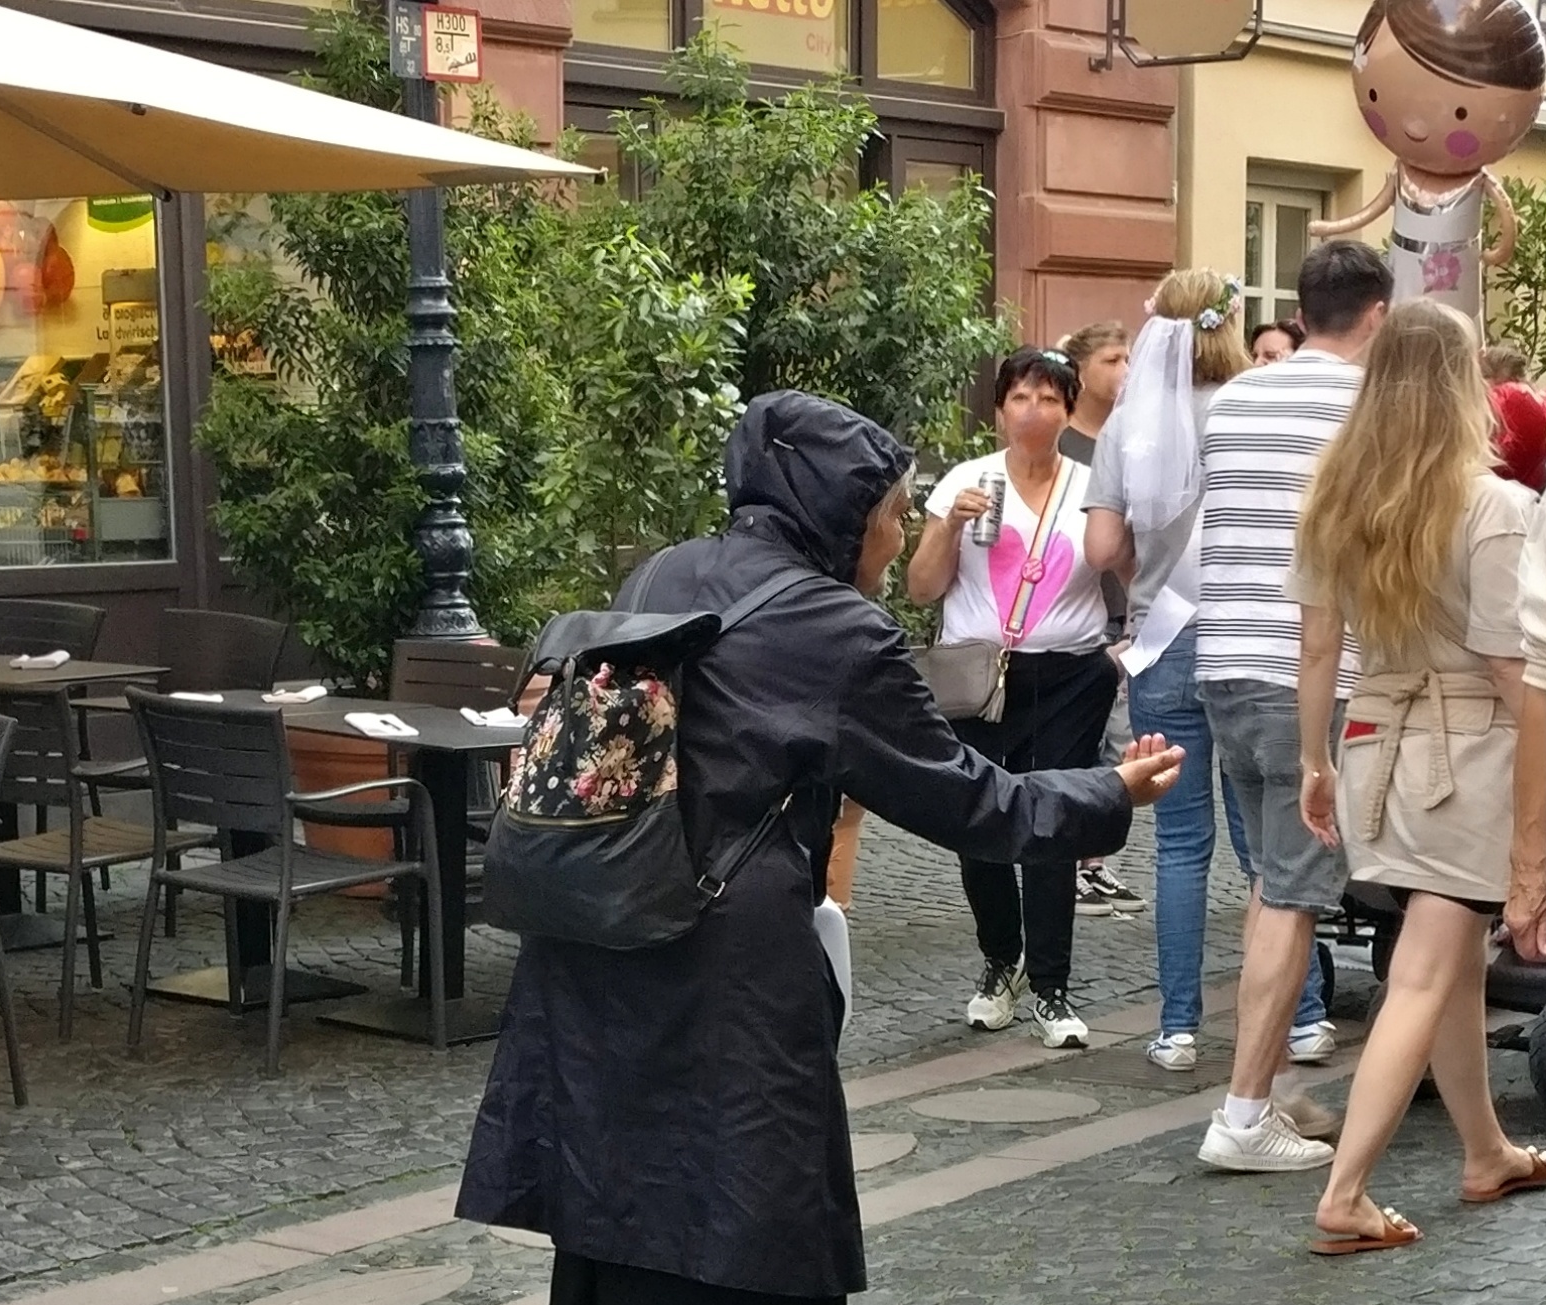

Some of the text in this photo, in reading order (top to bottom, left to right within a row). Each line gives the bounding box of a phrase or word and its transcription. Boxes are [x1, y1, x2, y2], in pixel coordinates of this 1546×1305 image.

[395, 16, 409, 35] HS
[436, 13, 466, 32] H300
[805, 32, 832, 56] City
